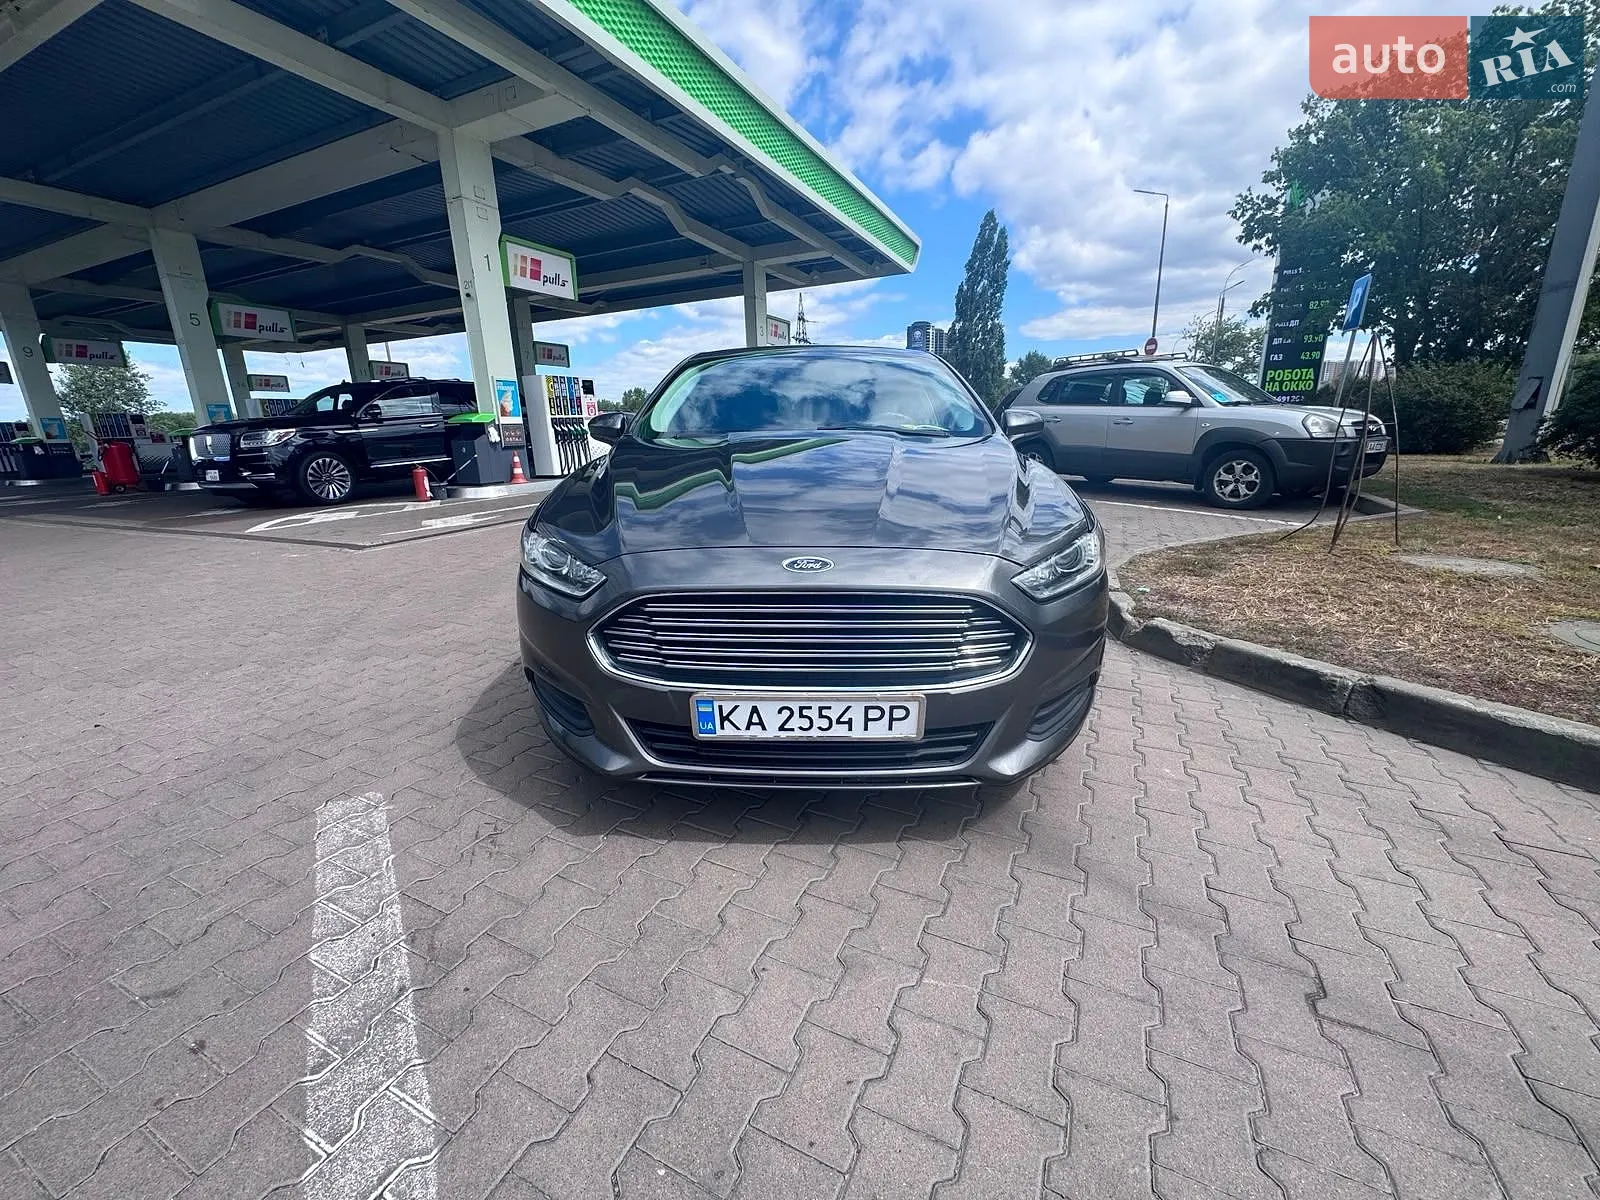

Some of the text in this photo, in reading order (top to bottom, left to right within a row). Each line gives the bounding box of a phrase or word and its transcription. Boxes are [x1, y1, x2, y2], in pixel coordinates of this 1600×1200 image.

[542, 272, 569, 287] pulls
[189, 313, 200, 326] 5
[258, 322, 288, 333] pulls
[23, 346, 33, 357] 9
[1270, 353, 1284, 361] ГАЗ
[1300, 351, 1321, 361] 43.90
[1266, 368, 1315, 381] РОБОТА
[1264, 380, 1314, 392] НА ОККО
[794, 559, 822, 569] Ford
[717, 704, 911, 732] KA 2554 PP
[700, 722, 714, 731] UA
